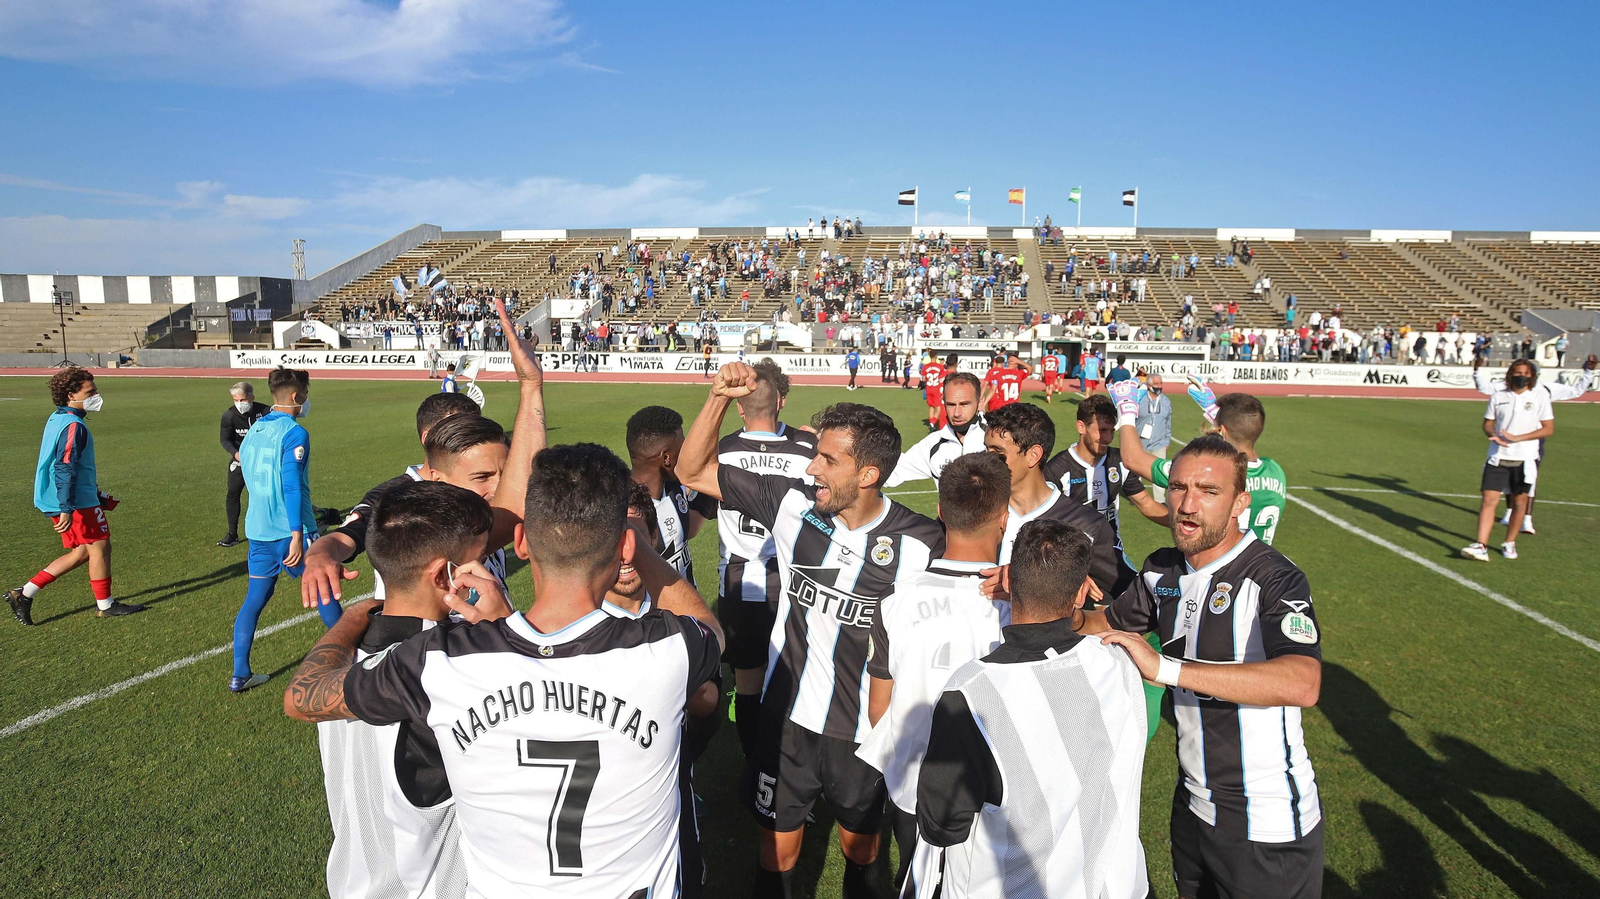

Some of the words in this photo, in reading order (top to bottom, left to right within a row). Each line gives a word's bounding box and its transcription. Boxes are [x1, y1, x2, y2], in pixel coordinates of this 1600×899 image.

[240, 355, 271, 367] aqualia
[281, 354, 318, 364] Socibus
[325, 355, 369, 363] LEGEA
[371, 355, 416, 364] LEGEA
[633, 362, 664, 370] MATA
[1045, 361, 1056, 371] 22
[926, 373, 940, 386] 32
[1233, 367, 1258, 380] ZABAL
[1260, 366, 1289, 380] BAÑOS
[1363, 369, 1408, 385] MENA
[1001, 382, 1019, 401] 14
[740, 455, 791, 473] DANESE
[800, 507, 834, 536] LEGEA
[786, 569, 876, 629] LOTUS
[1290, 627, 1313, 636] SPORT
[451, 680, 535, 754] NACHO
[541, 679, 659, 750] HUERTAS
[757, 771, 777, 808] 5
[516, 738, 601, 877] 7
